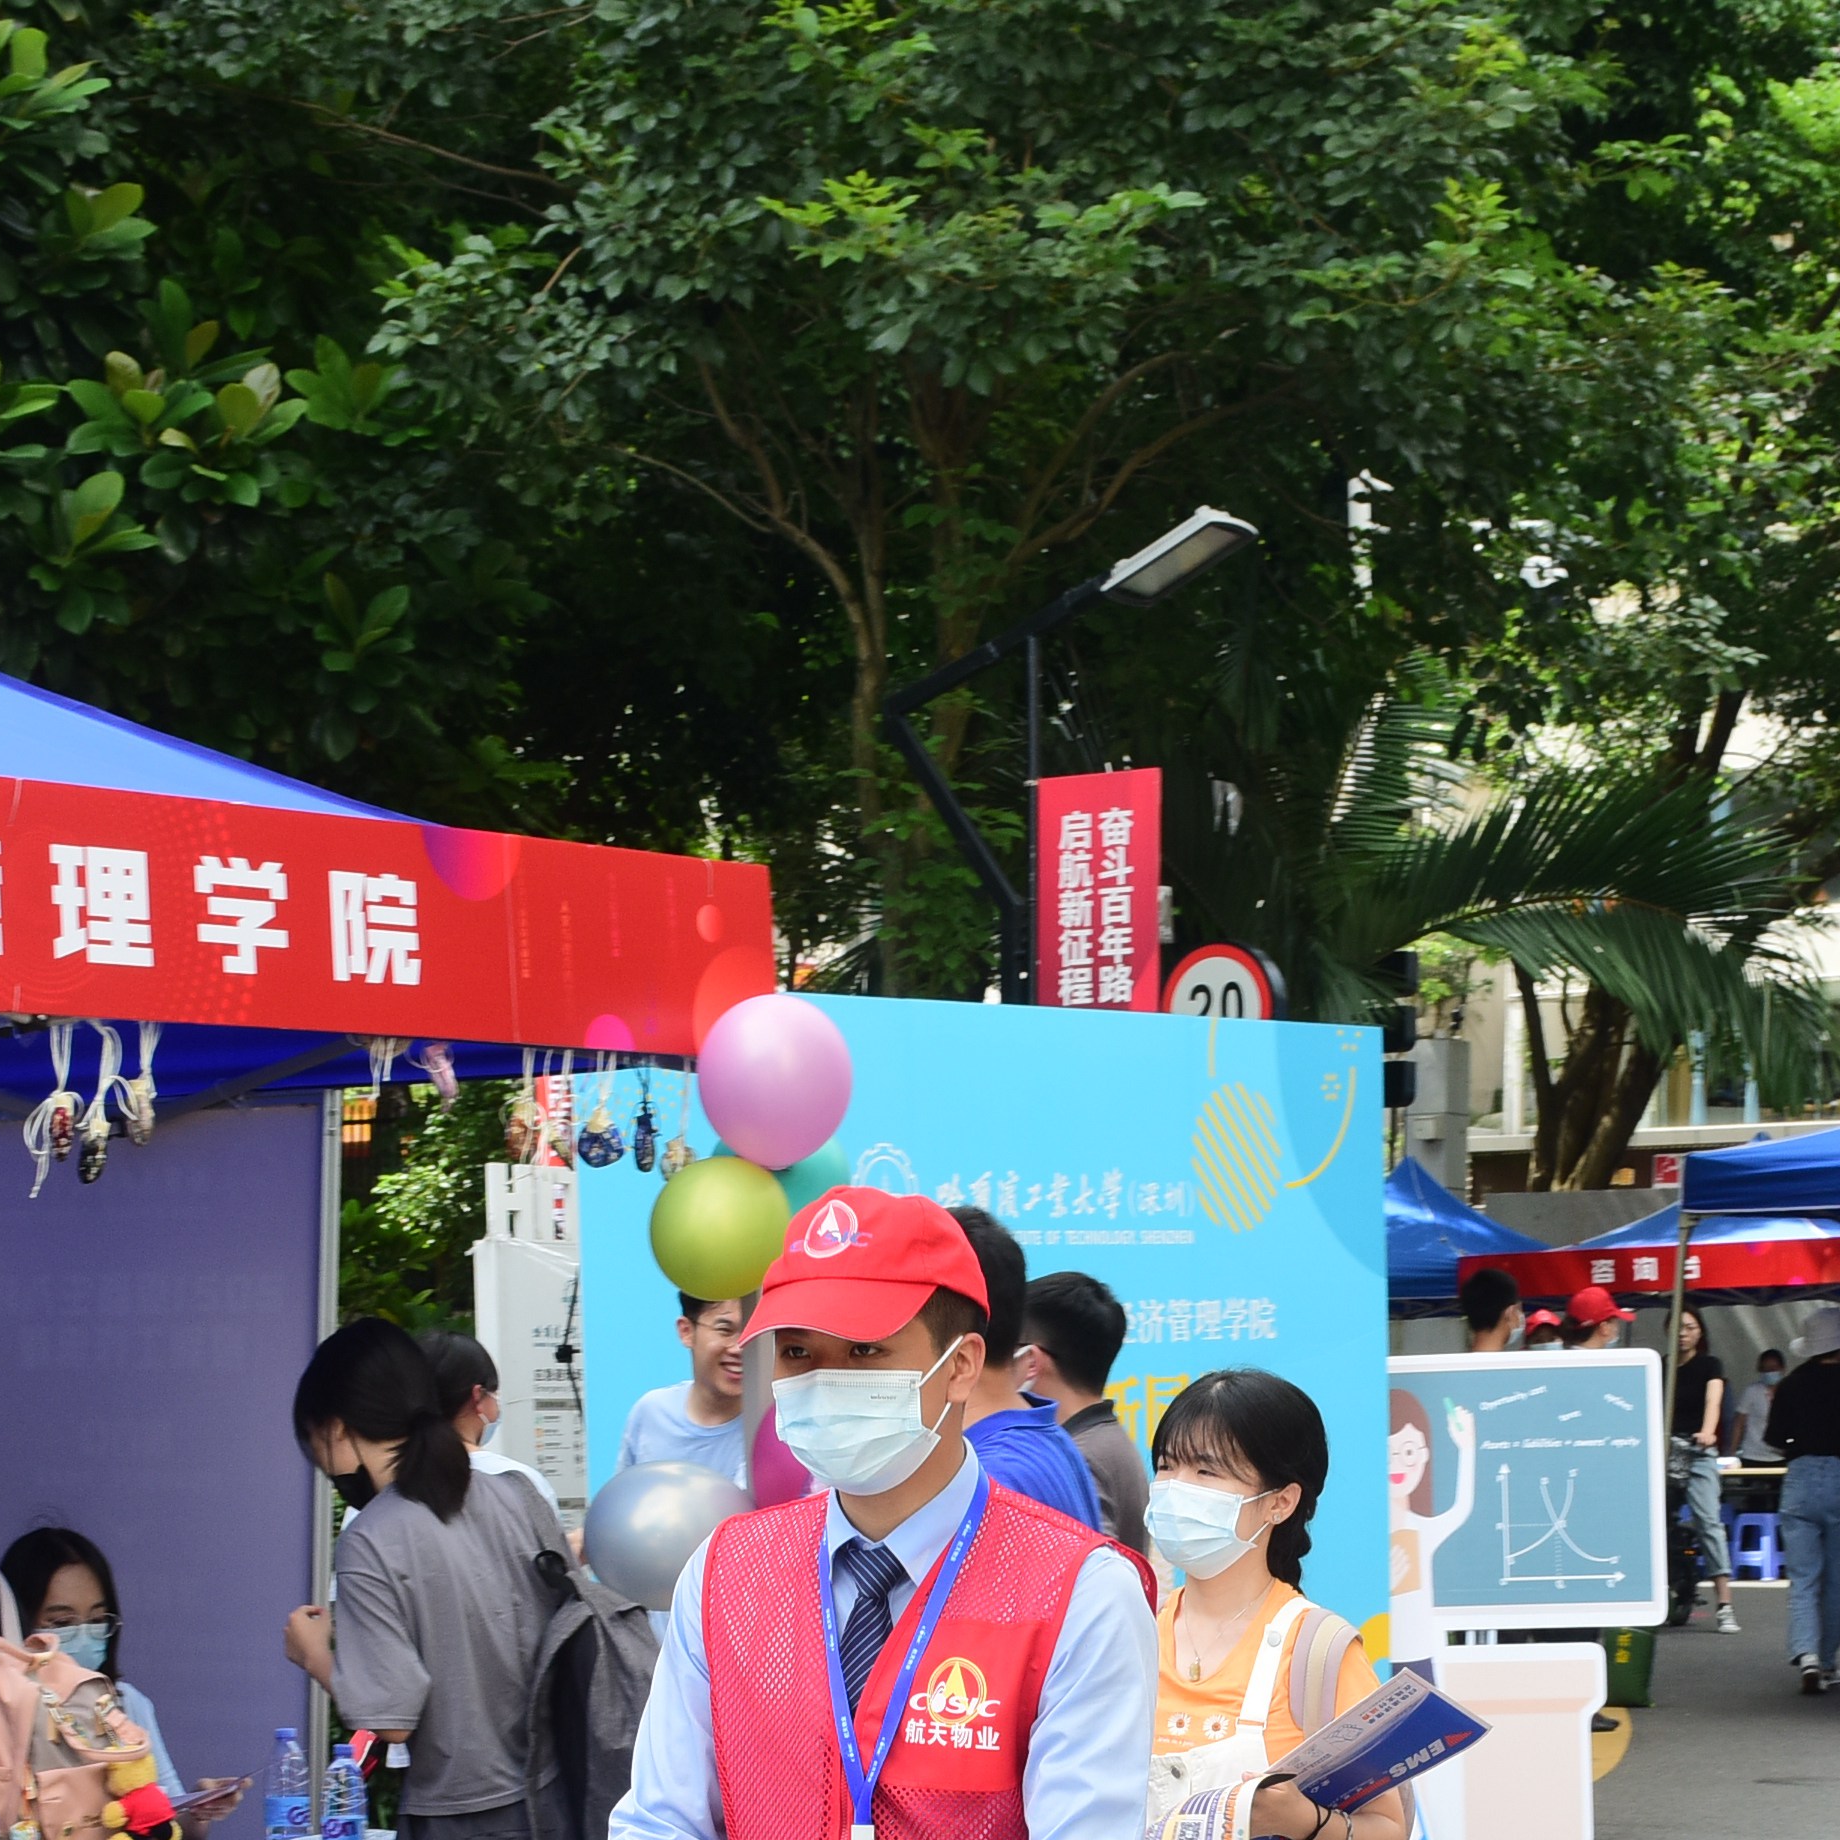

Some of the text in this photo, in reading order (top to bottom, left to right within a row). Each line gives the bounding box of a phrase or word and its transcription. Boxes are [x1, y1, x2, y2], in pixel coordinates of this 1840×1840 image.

[1057, 810, 1095, 1007] 启航新征程
[1097, 806, 1135, 1004] 奋斗百年路
[1189, 981, 1244, 1018] 20
[905, 1718, 1001, 1751] 航天物业
[1388, 1738, 1446, 1779] EMS
